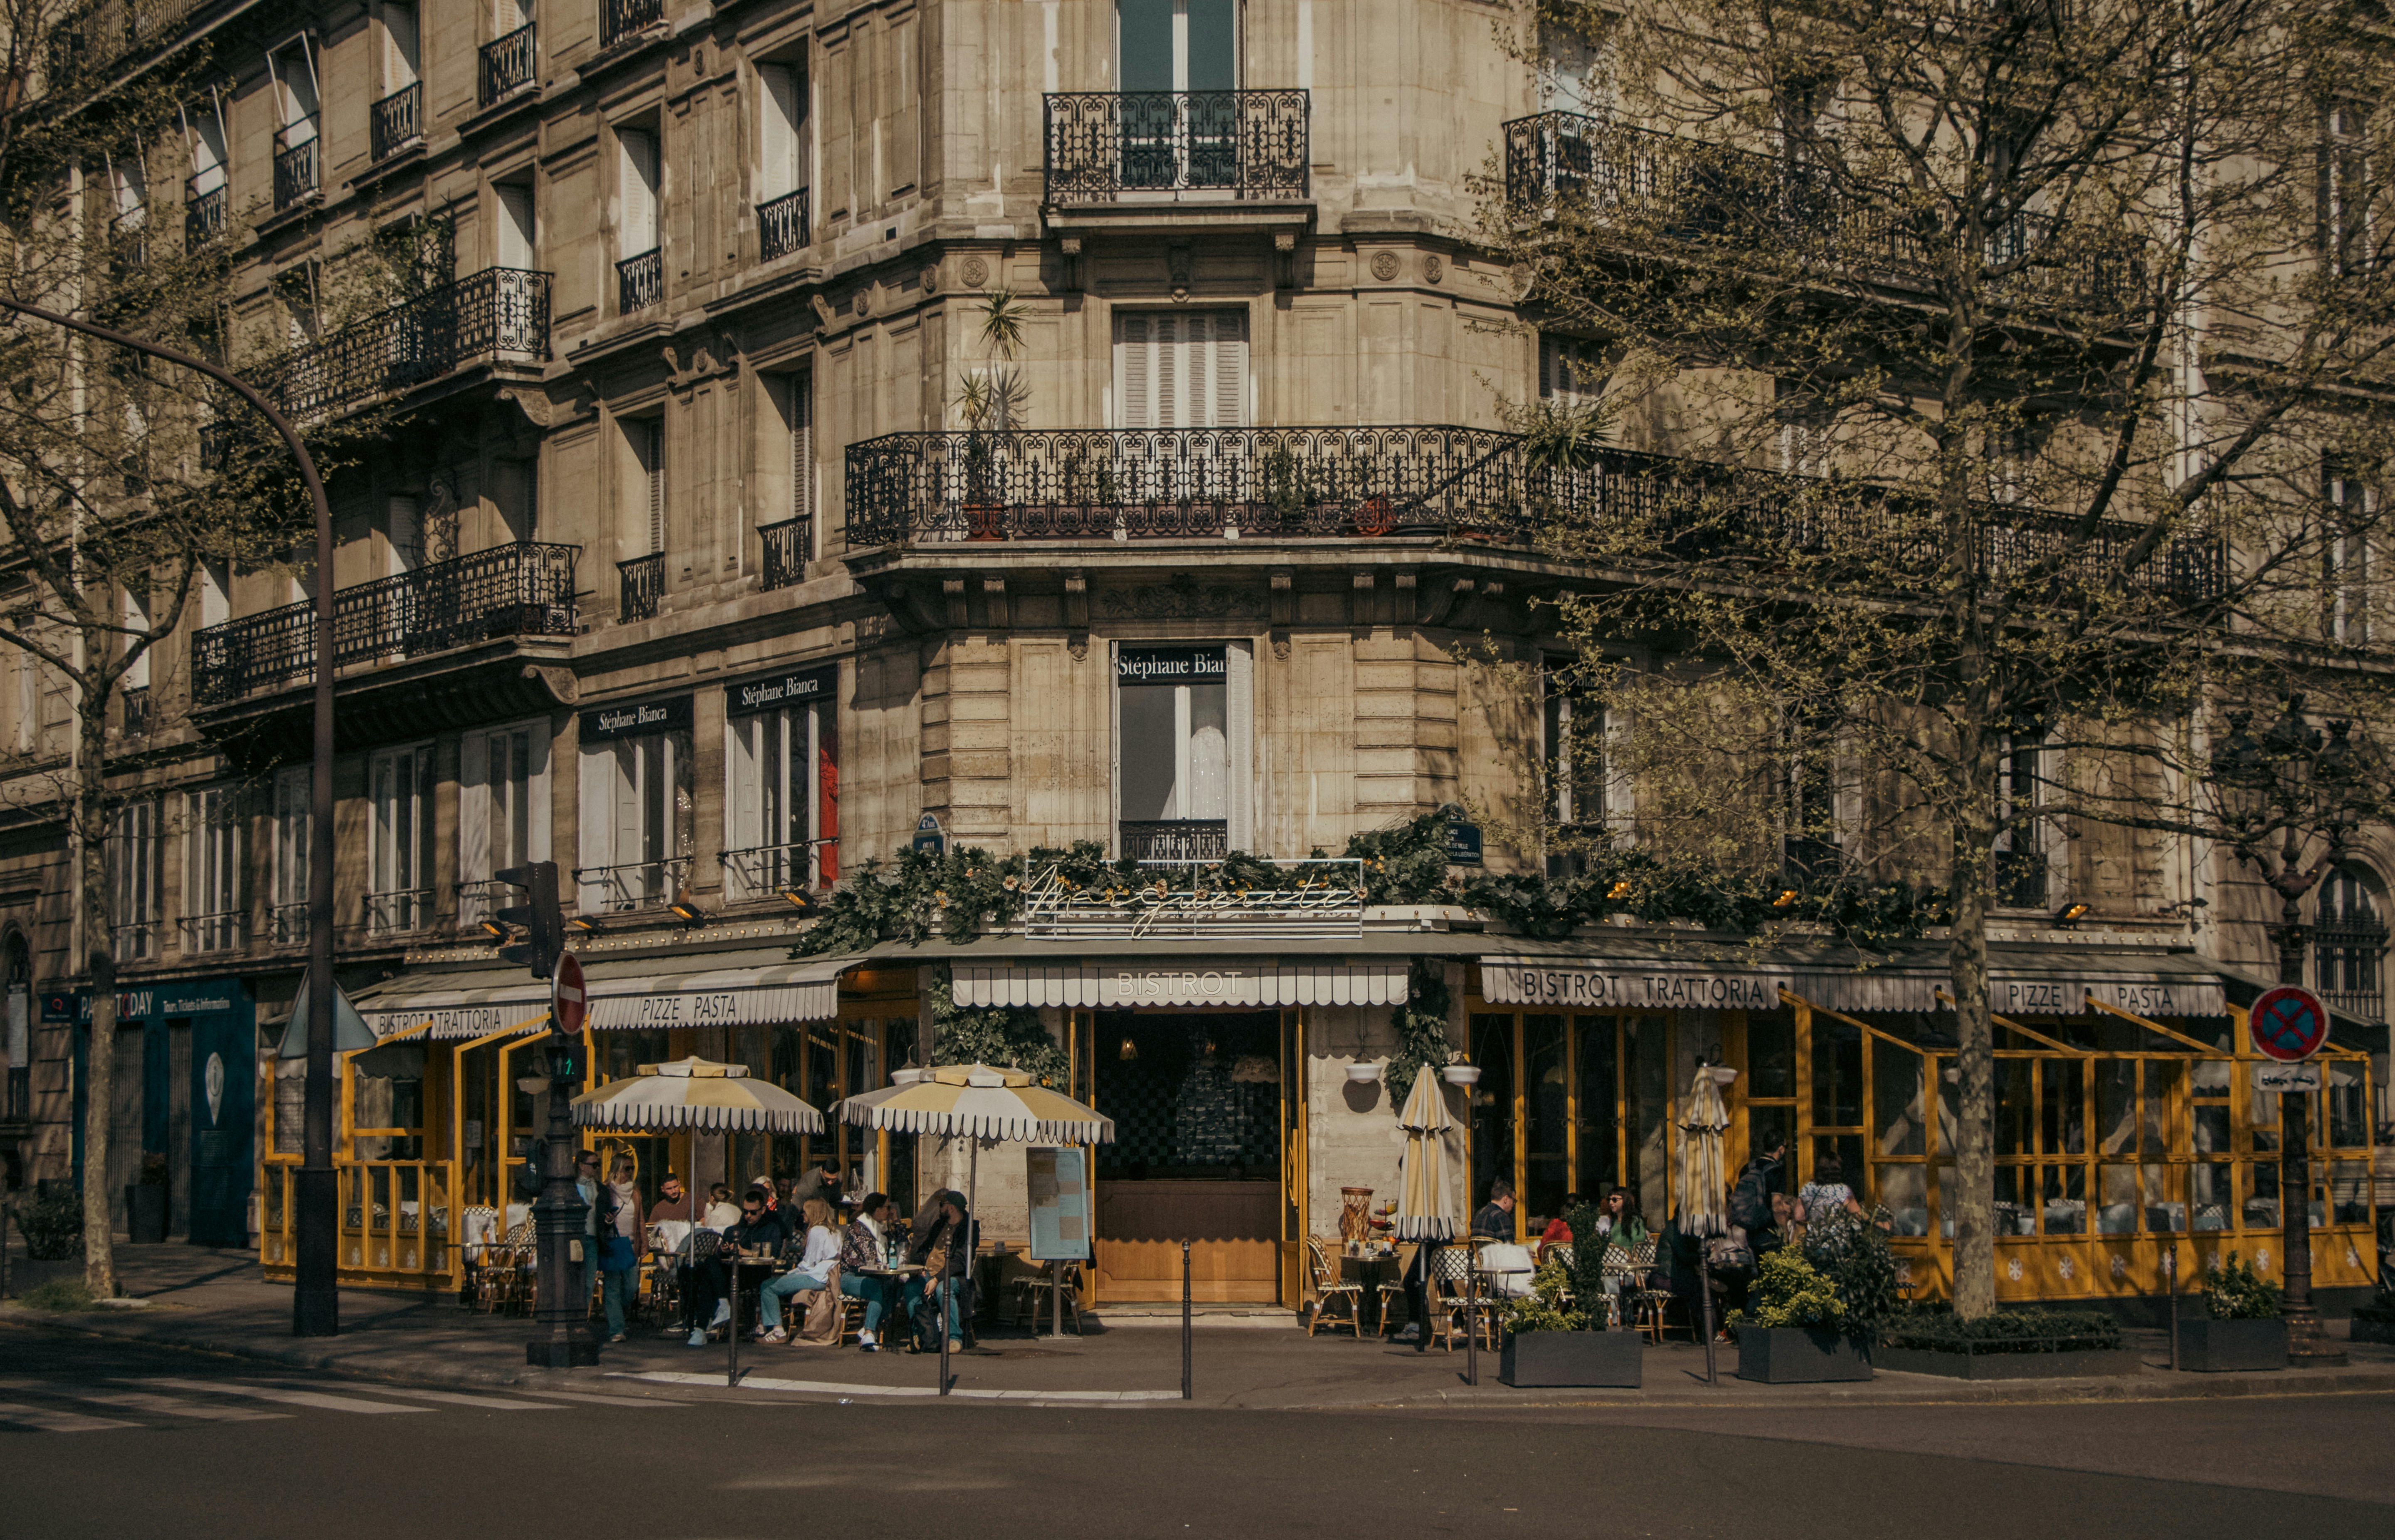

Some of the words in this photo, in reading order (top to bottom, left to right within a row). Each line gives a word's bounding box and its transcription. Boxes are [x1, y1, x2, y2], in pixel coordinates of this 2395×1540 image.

[1119, 655, 1189, 679] Stéphane
[742, 683, 784, 707] Stéphane
[786, 676, 818, 697] Bianca
[599, 710, 636, 733] Stéphane
[638, 705, 667, 724] Bianca
[1117, 971, 1243, 996] BISTROT
[1524, 973, 1620, 999] BISTROT
[1642, 977, 1764, 1003] TRATTORIA
[2009, 985, 2062, 1007] PIZZE
[641, 998, 681, 1020] PIZZE
[694, 995, 736, 1018] PASTA
[2118, 987, 2174, 1009] PASTA
[379, 1013, 425, 1035] BISTROT
[437, 1009, 501, 1032] TRATTORIA
